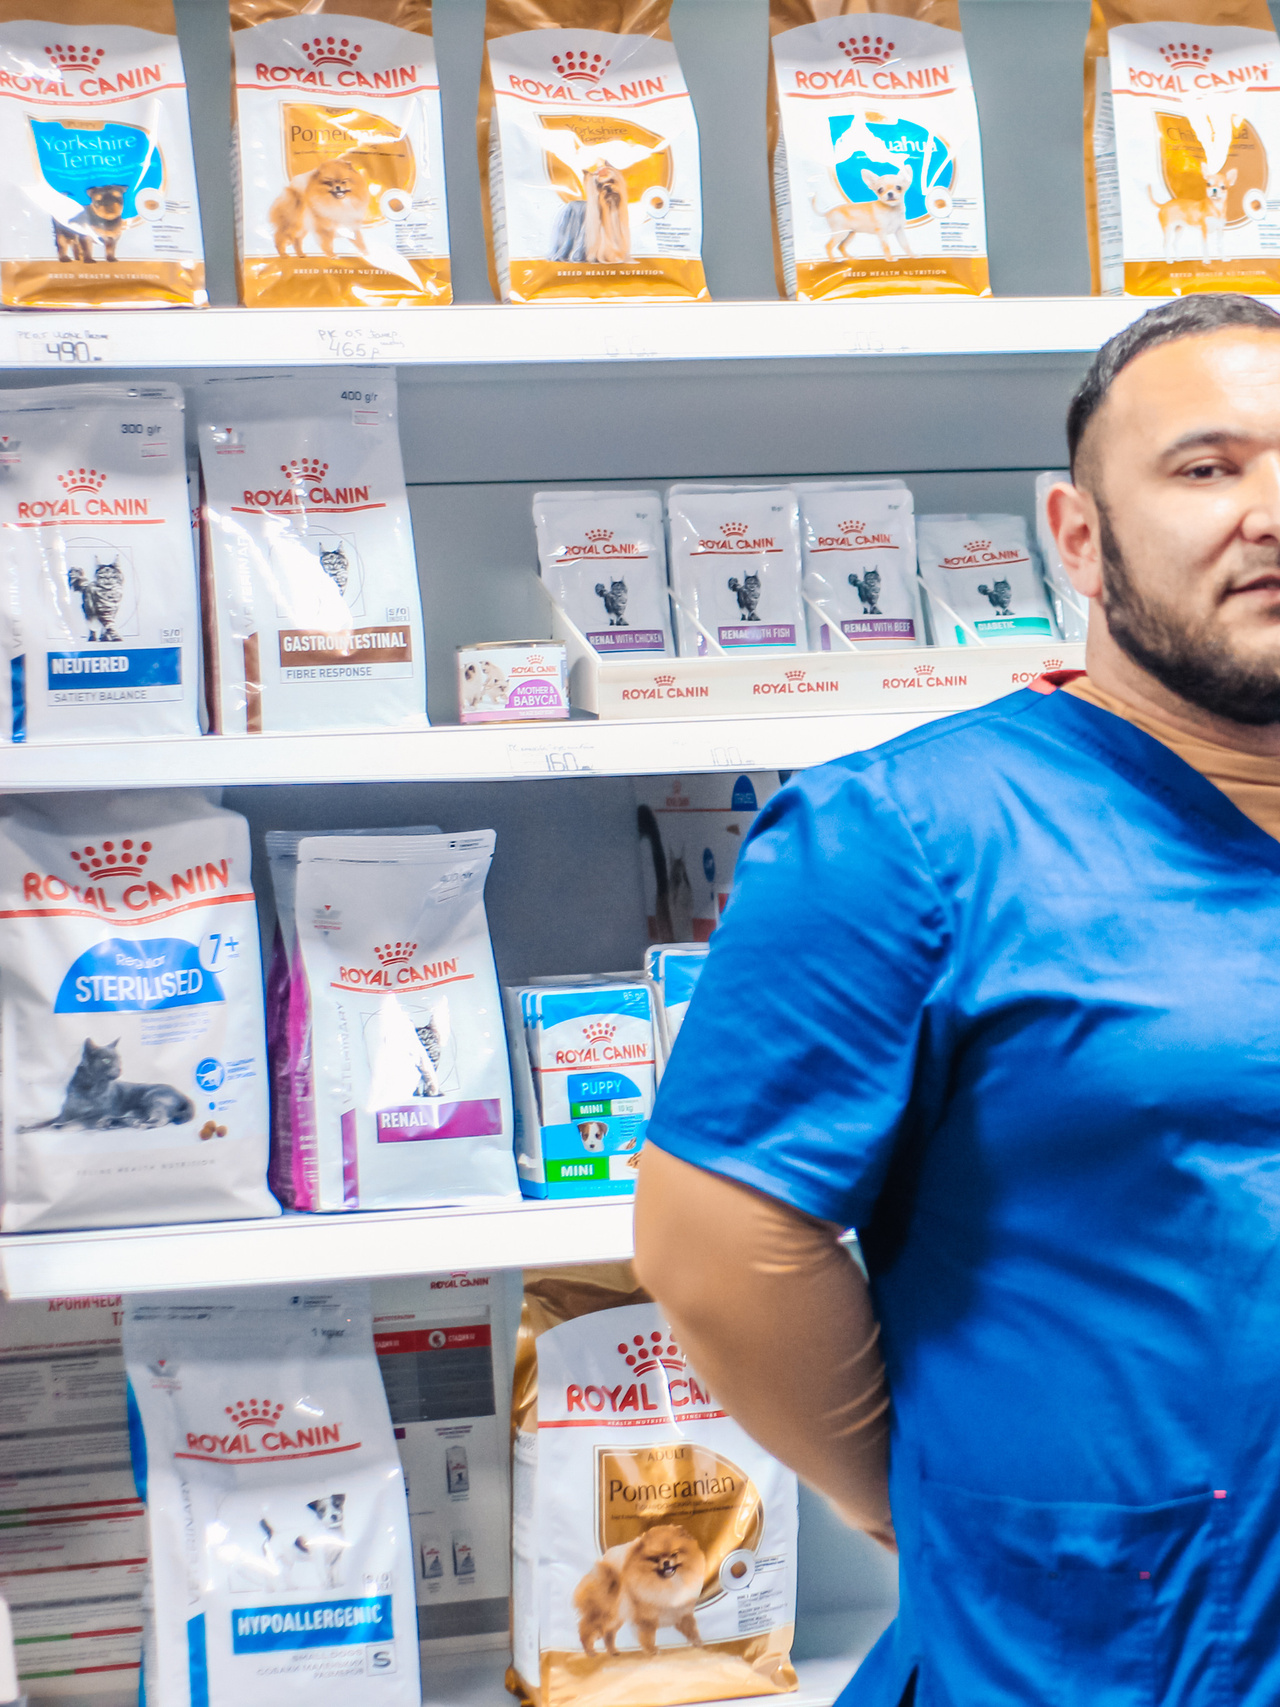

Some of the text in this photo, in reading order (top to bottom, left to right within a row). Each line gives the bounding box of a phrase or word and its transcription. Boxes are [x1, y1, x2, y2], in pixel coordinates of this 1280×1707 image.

[0, 65, 162, 97] ROYAL CANIN
[255, 63, 417, 89] ROYAL CANIN
[795, 66, 950, 90] ROYAL CANIN
[1129, 63, 1269, 93] ROYAL CANIN
[508, 75, 665, 102] ROYAL CANIN
[565, 123, 628, 135] Yorkshire
[41, 134, 138, 154] Yorkshire
[322, 268, 354, 276] HEALTH
[329, 341, 367, 357] 465
[340, 391, 362, 401] 400
[121, 424, 162, 436] 300 g/r
[308, 486, 369, 504] CANIN
[18, 499, 148, 519] ROYAL CANIN
[699, 537, 774, 550] ROYAL CANIN
[818, 533, 891, 547] ROYAL CANIN
[565, 544, 600, 555] ROYAL
[944, 550, 1020, 566] ROYAL CANIN
[844, 622, 911, 633] RENAL WITH BEEF
[977, 621, 1015, 631] DIABETIC
[589, 633, 663, 646] RENAL WITH CHICKEN
[721, 628, 790, 640] RENAL FISH
[283, 632, 407, 652] GASTROINTESTINAL
[52, 656, 129, 674] NEUTERED
[512, 666, 536, 674] ROYAL
[286, 667, 372, 679] FIBRE RESPONSE
[752, 681, 839, 695] ROYAL CANIN
[882, 675, 967, 689] ROYAL CANIN
[54, 689, 147, 703] SATIETY BALANCE
[517, 686, 548, 695] MOTHER
[622, 686, 709, 701] ROYAL CANIN
[513, 694, 558, 706] BABYCAT
[22, 858, 229, 913] ROYAL CANIN
[339, 958, 457, 987] ROYAL CANIN
[75, 968, 203, 1003] STERILISED
[556, 1043, 648, 1065] ROYAL CANIN
[581, 1079, 622, 1096] PUPPY
[579, 1103, 604, 1115] MINI
[380, 1111, 428, 1129] RENAL
[560, 1163, 594, 1177] MINI
[430, 1278, 490, 1290] ROYAL CANIN
[566, 1383, 658, 1412] ROYAL
[186, 1423, 341, 1454] ROYAL CANIN
[647, 1448, 686, 1461] ADULT
[609, 1473, 735, 1502] Pomeranian
[237, 1603, 383, 1636] HYPOALLERGENIC
[373, 1651, 392, 1668] S
